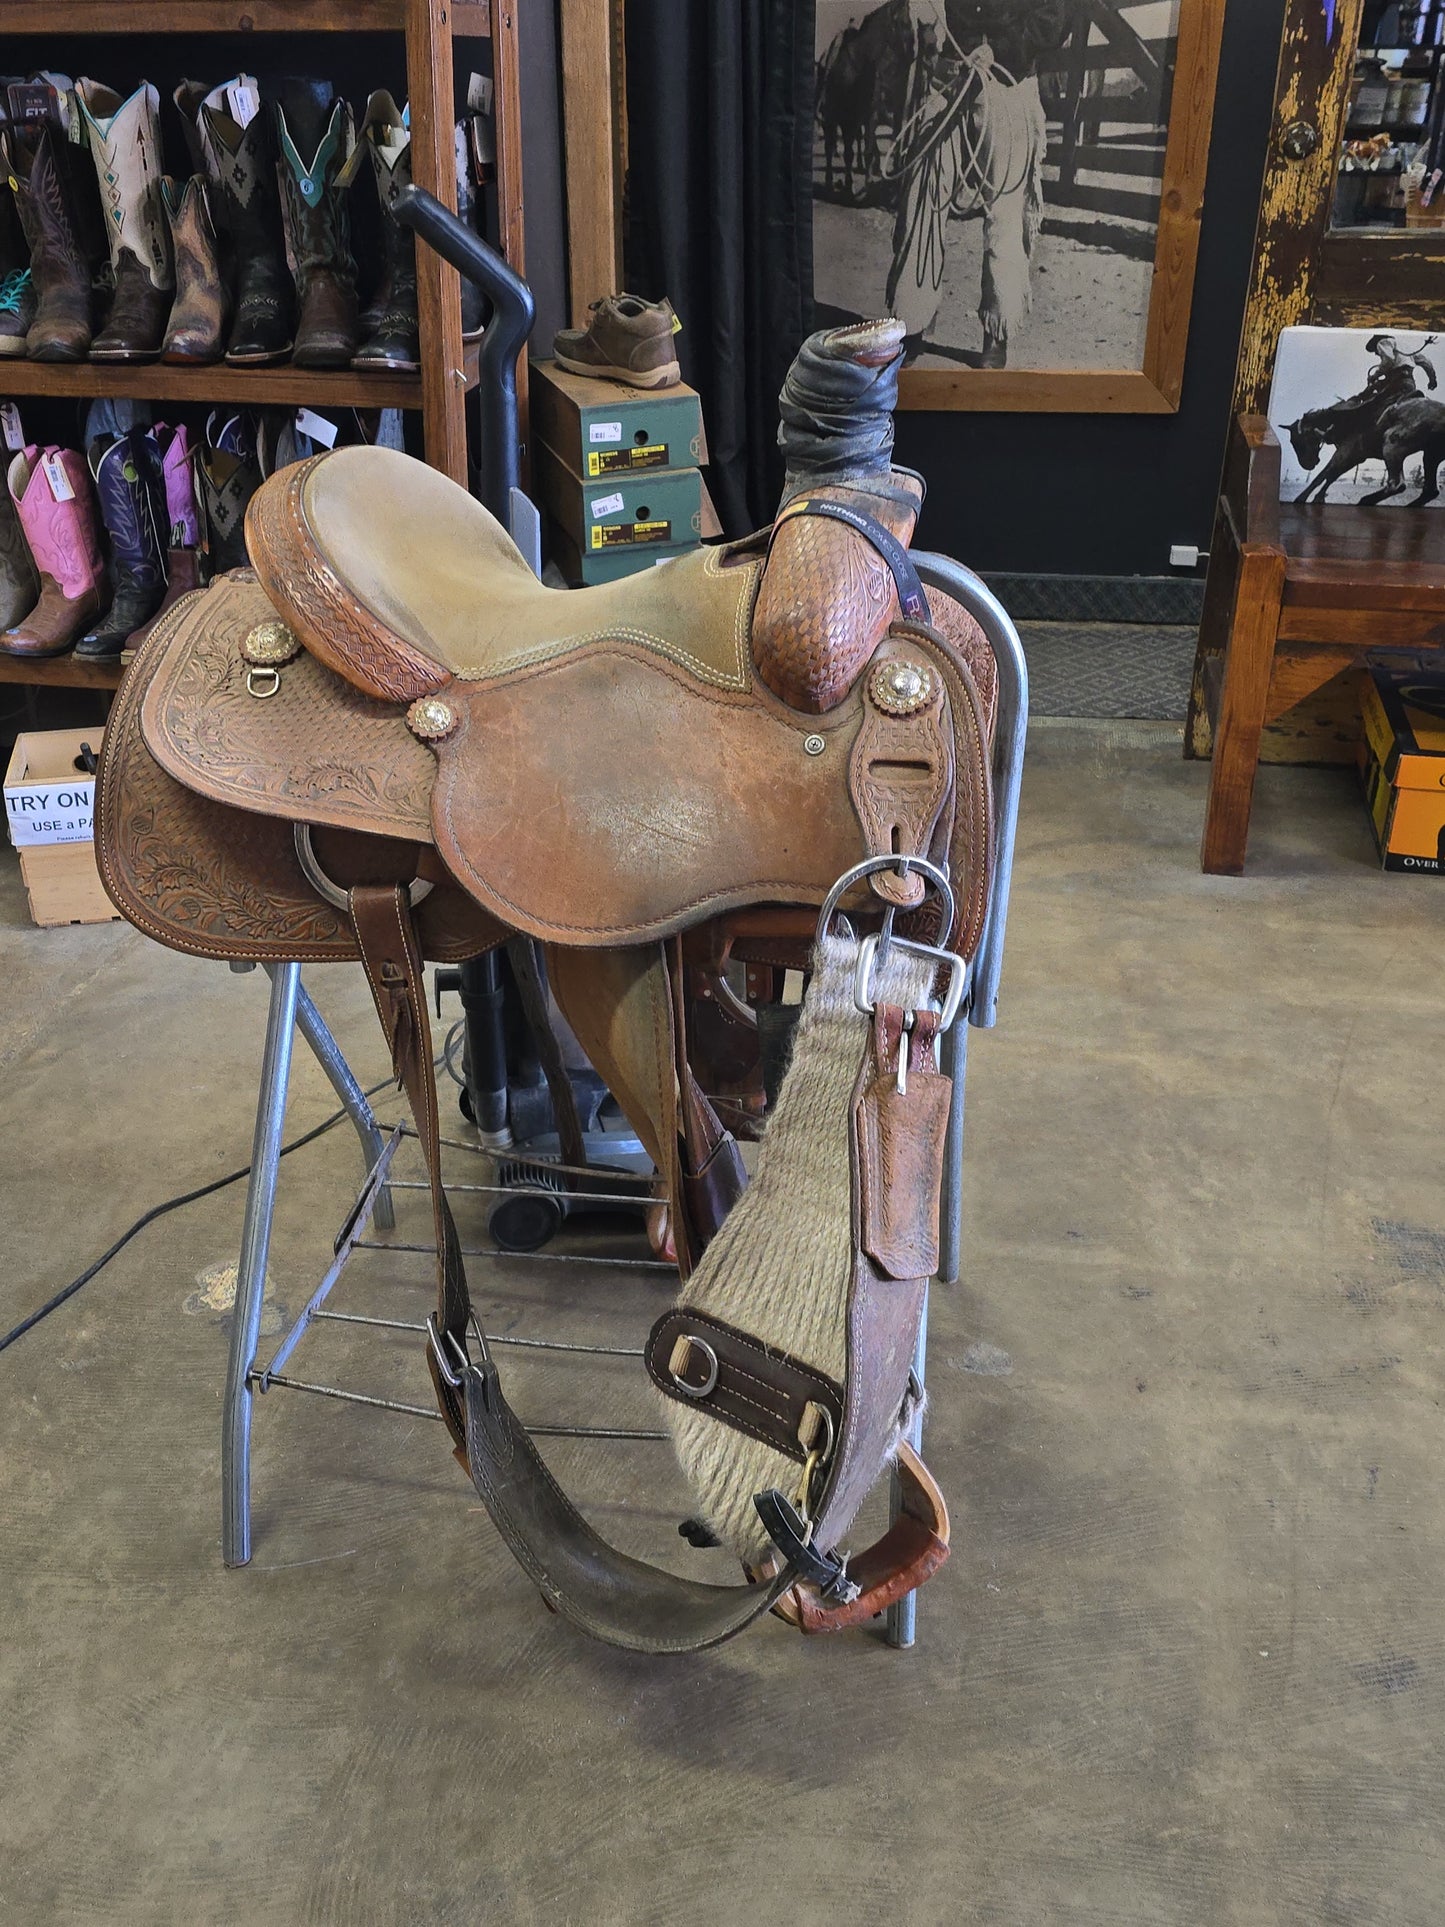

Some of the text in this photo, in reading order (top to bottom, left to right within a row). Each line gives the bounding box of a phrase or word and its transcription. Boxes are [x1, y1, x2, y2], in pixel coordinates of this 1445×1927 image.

[25, 107, 47, 117] FIT
[820, 504, 867, 526] NOTHING
[6, 791, 89, 812] TRY ON
[32, 820, 62, 832] USE
[67, 821, 74, 829] a
